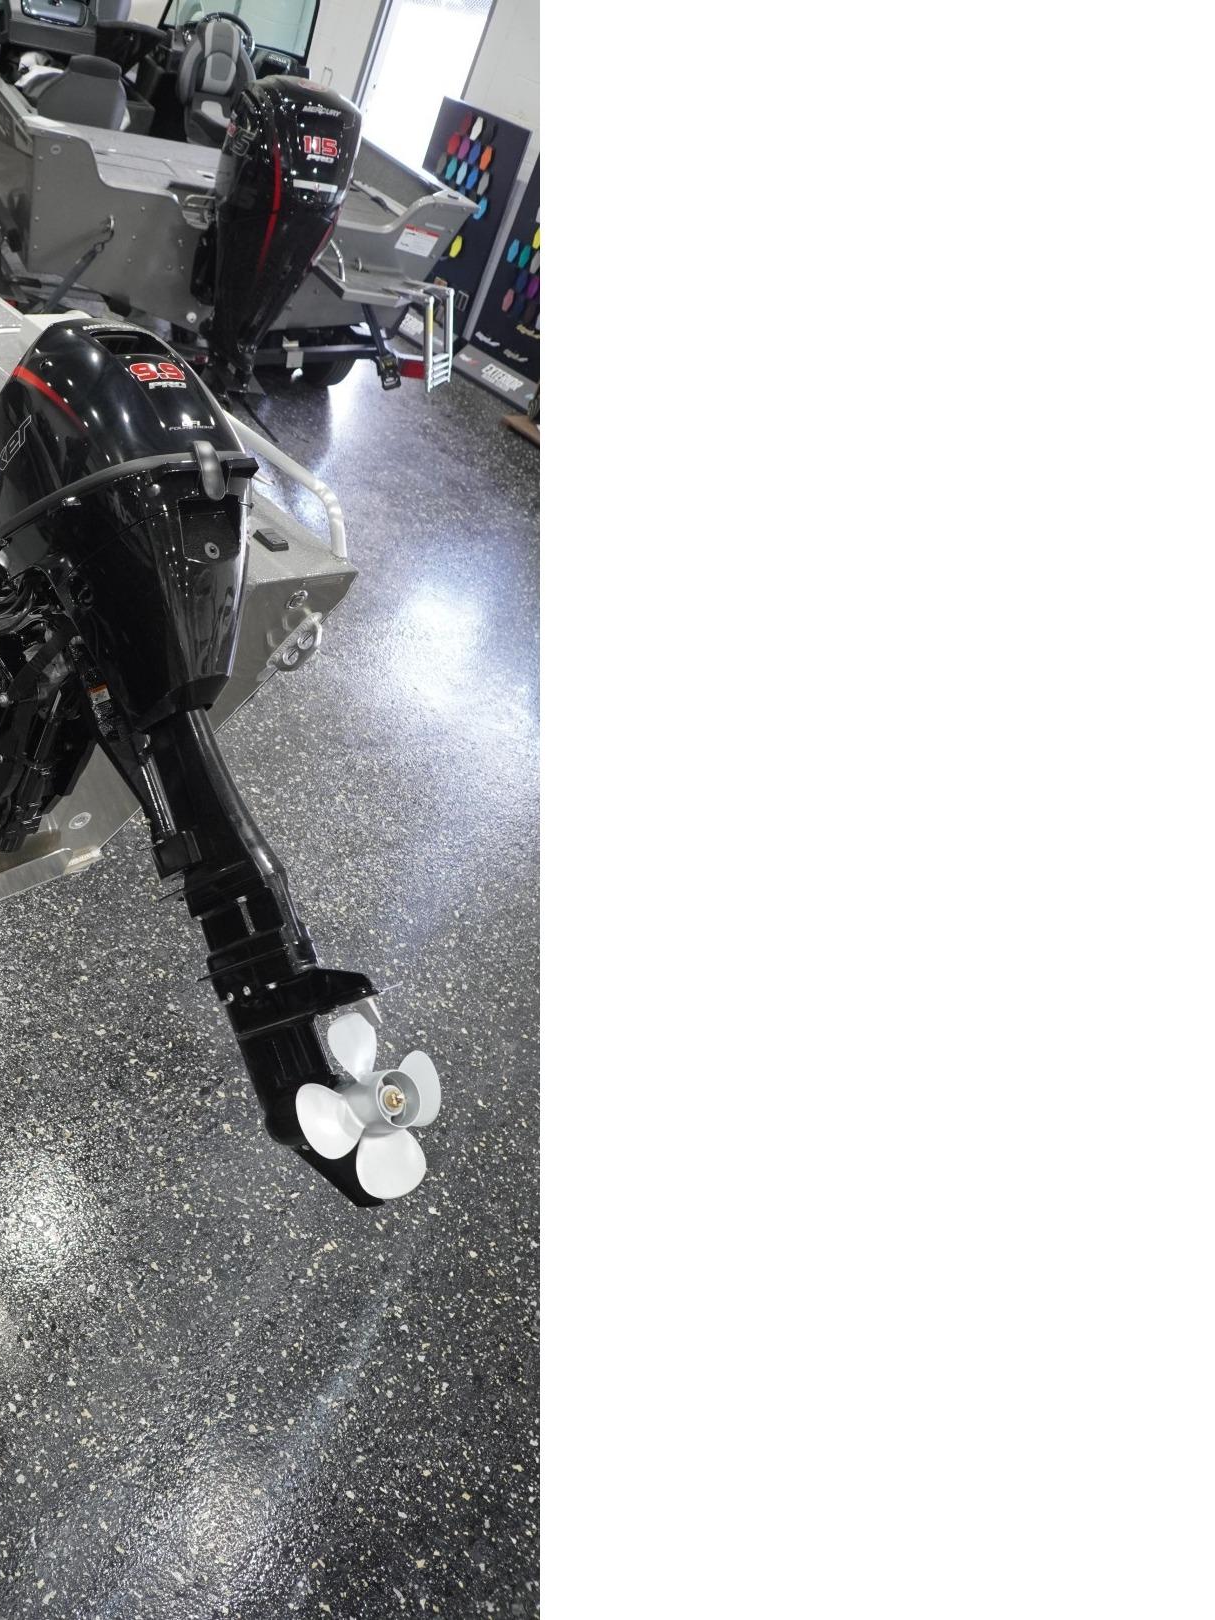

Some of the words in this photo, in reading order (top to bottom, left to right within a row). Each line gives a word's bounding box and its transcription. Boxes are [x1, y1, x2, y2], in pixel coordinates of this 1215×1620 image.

[302, 105, 342, 117] MERCURY
[303, 135, 337, 157] 115
[129, 362, 186, 381] 9.9
[148, 381, 187, 390] PRO
